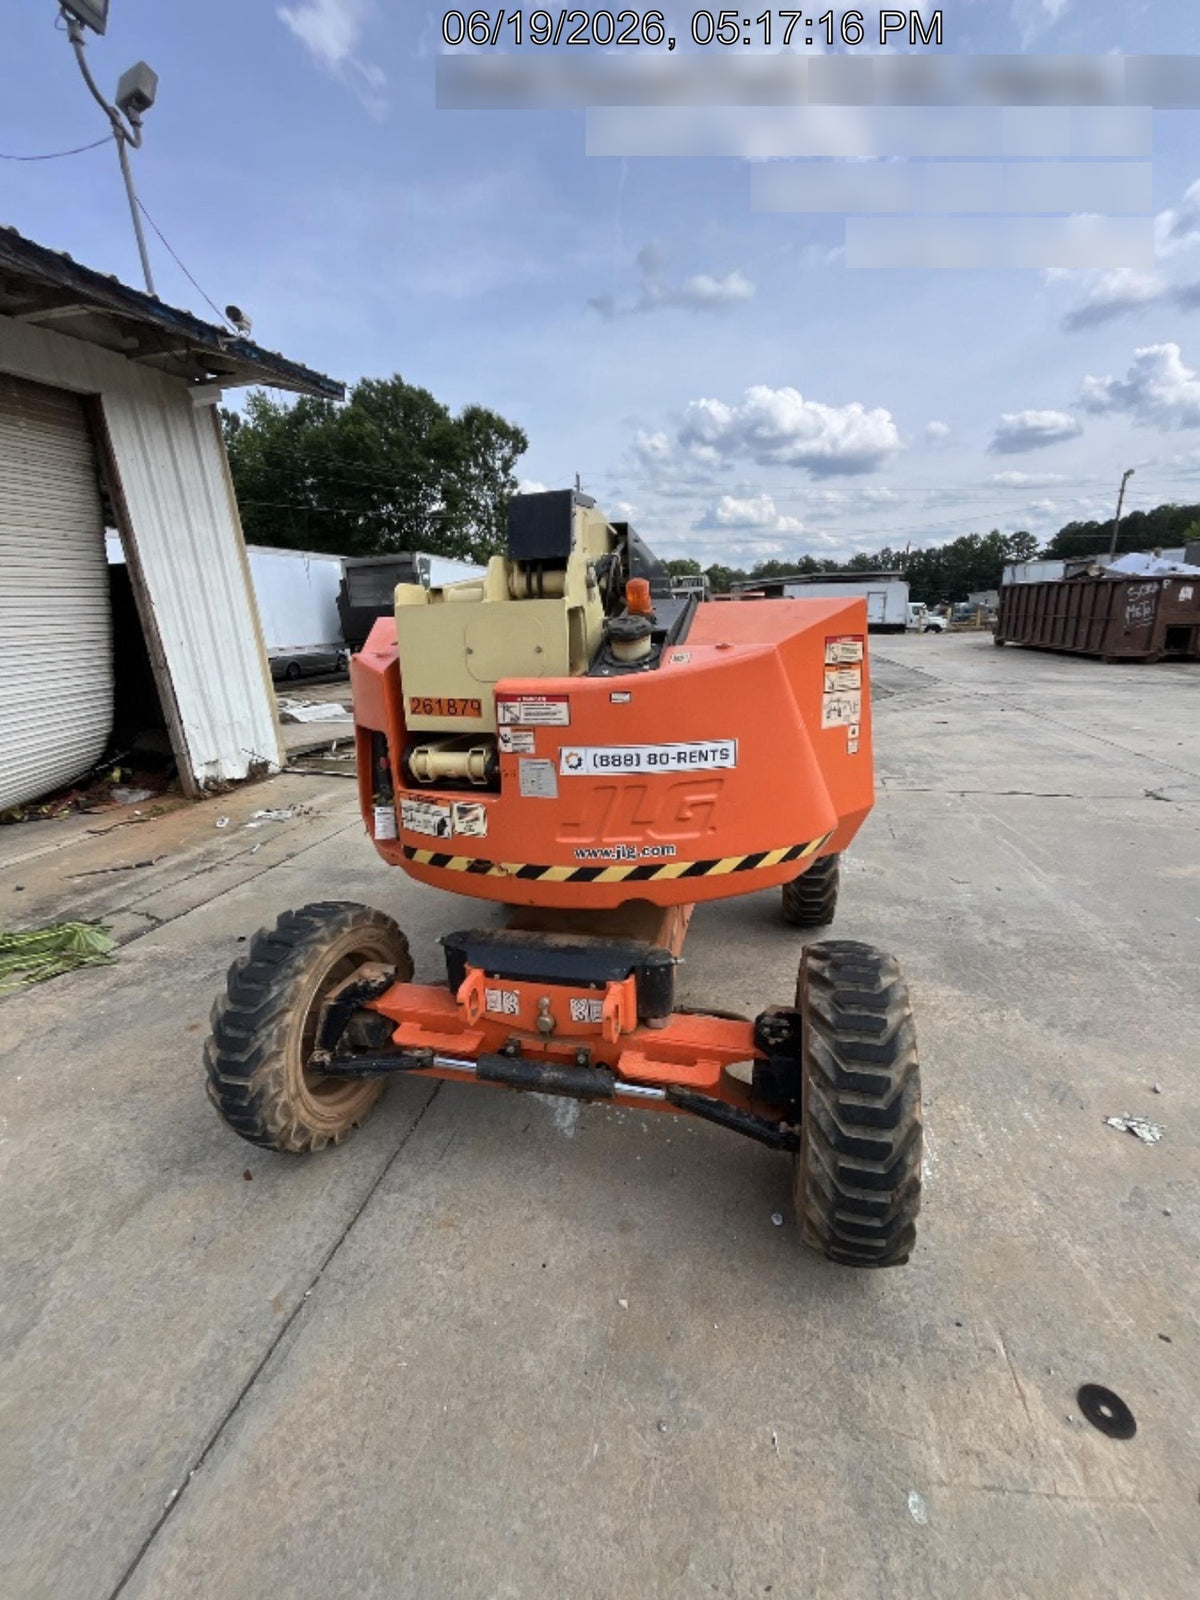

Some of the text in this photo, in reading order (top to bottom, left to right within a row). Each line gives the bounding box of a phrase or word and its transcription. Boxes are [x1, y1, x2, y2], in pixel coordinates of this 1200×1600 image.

[410, 697, 482, 716] 261879
[593, 747, 730, 768] (888) 80-RENTS
[555, 778, 725, 844] JLG
[574, 844, 677, 860] www.jlg.com
